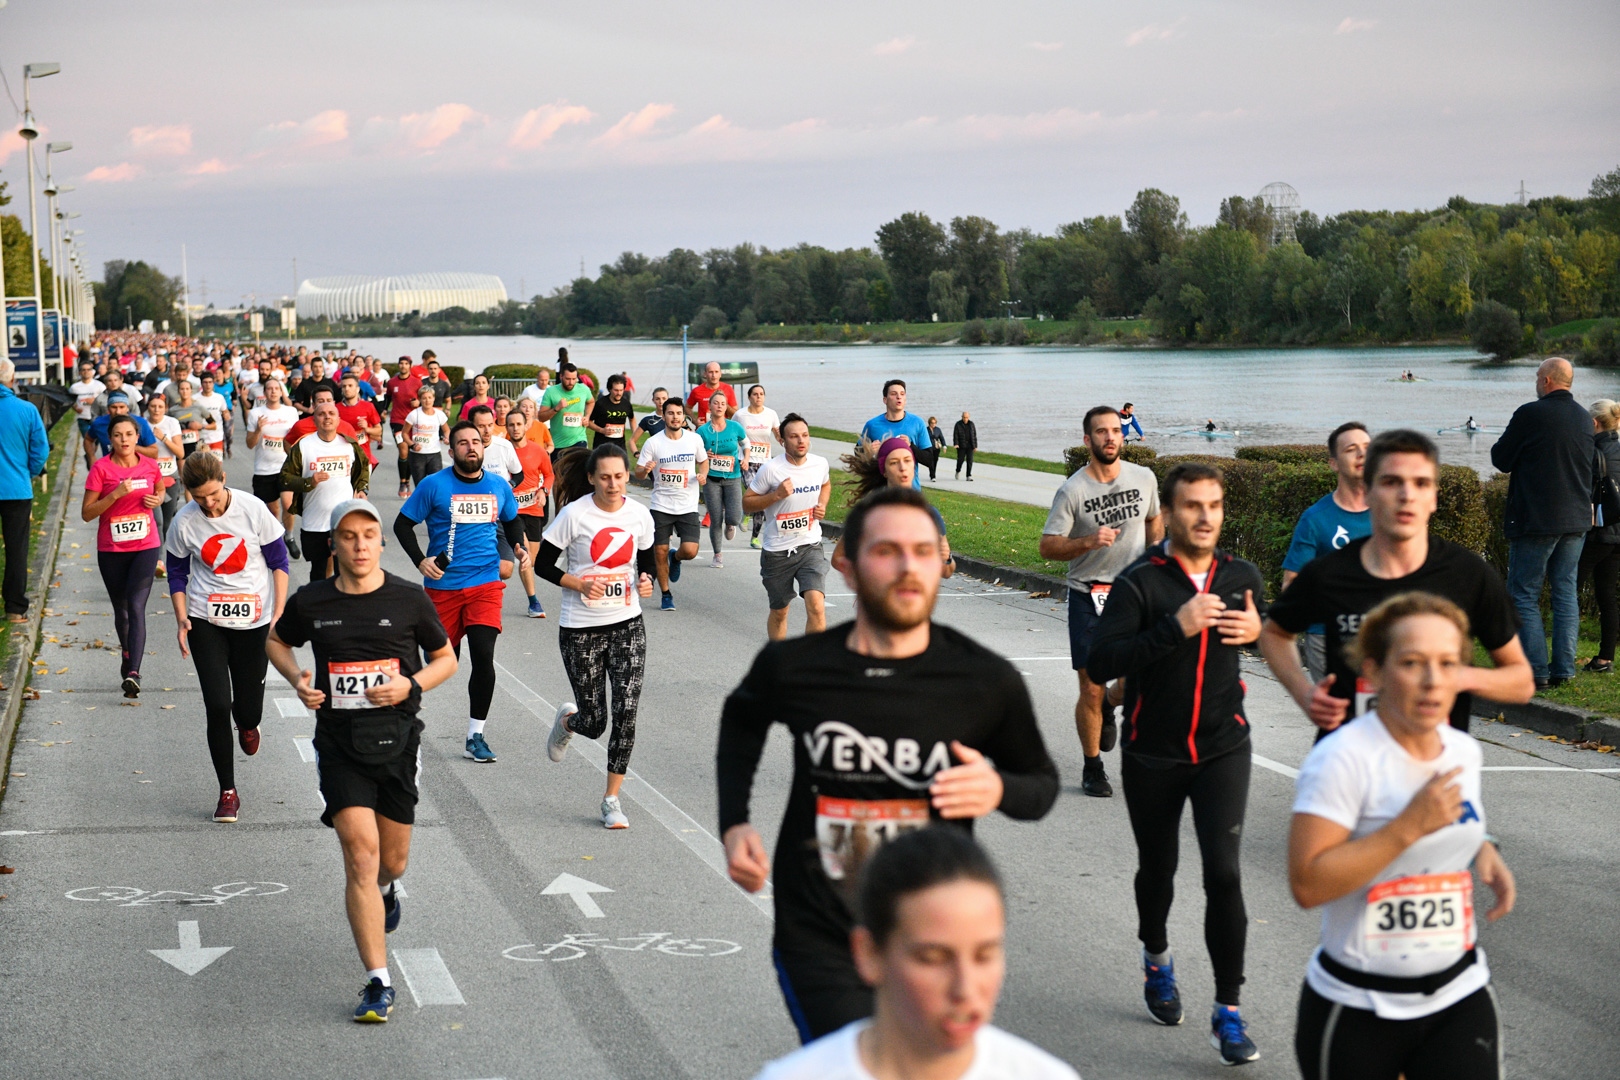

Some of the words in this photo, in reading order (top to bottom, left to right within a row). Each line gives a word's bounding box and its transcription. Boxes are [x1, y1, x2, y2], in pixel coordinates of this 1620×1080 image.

[265, 439, 282, 447] 2078
[660, 454, 694, 463] multicom
[712, 459, 731, 467] 5926
[320, 462, 344, 471] 3274
[661, 474, 682, 482] 5370
[1084, 489, 1143, 513] SHATTER
[458, 502, 488, 515] 4815
[1094, 504, 1140, 526] LIMITS
[115, 521, 143, 533] 1527
[781, 516, 808, 530] 4585
[212, 603, 250, 617] 7849
[336, 674, 384, 695] 4214
[803, 730, 951, 776] VERBA
[1377, 898, 1455, 931] 3625
